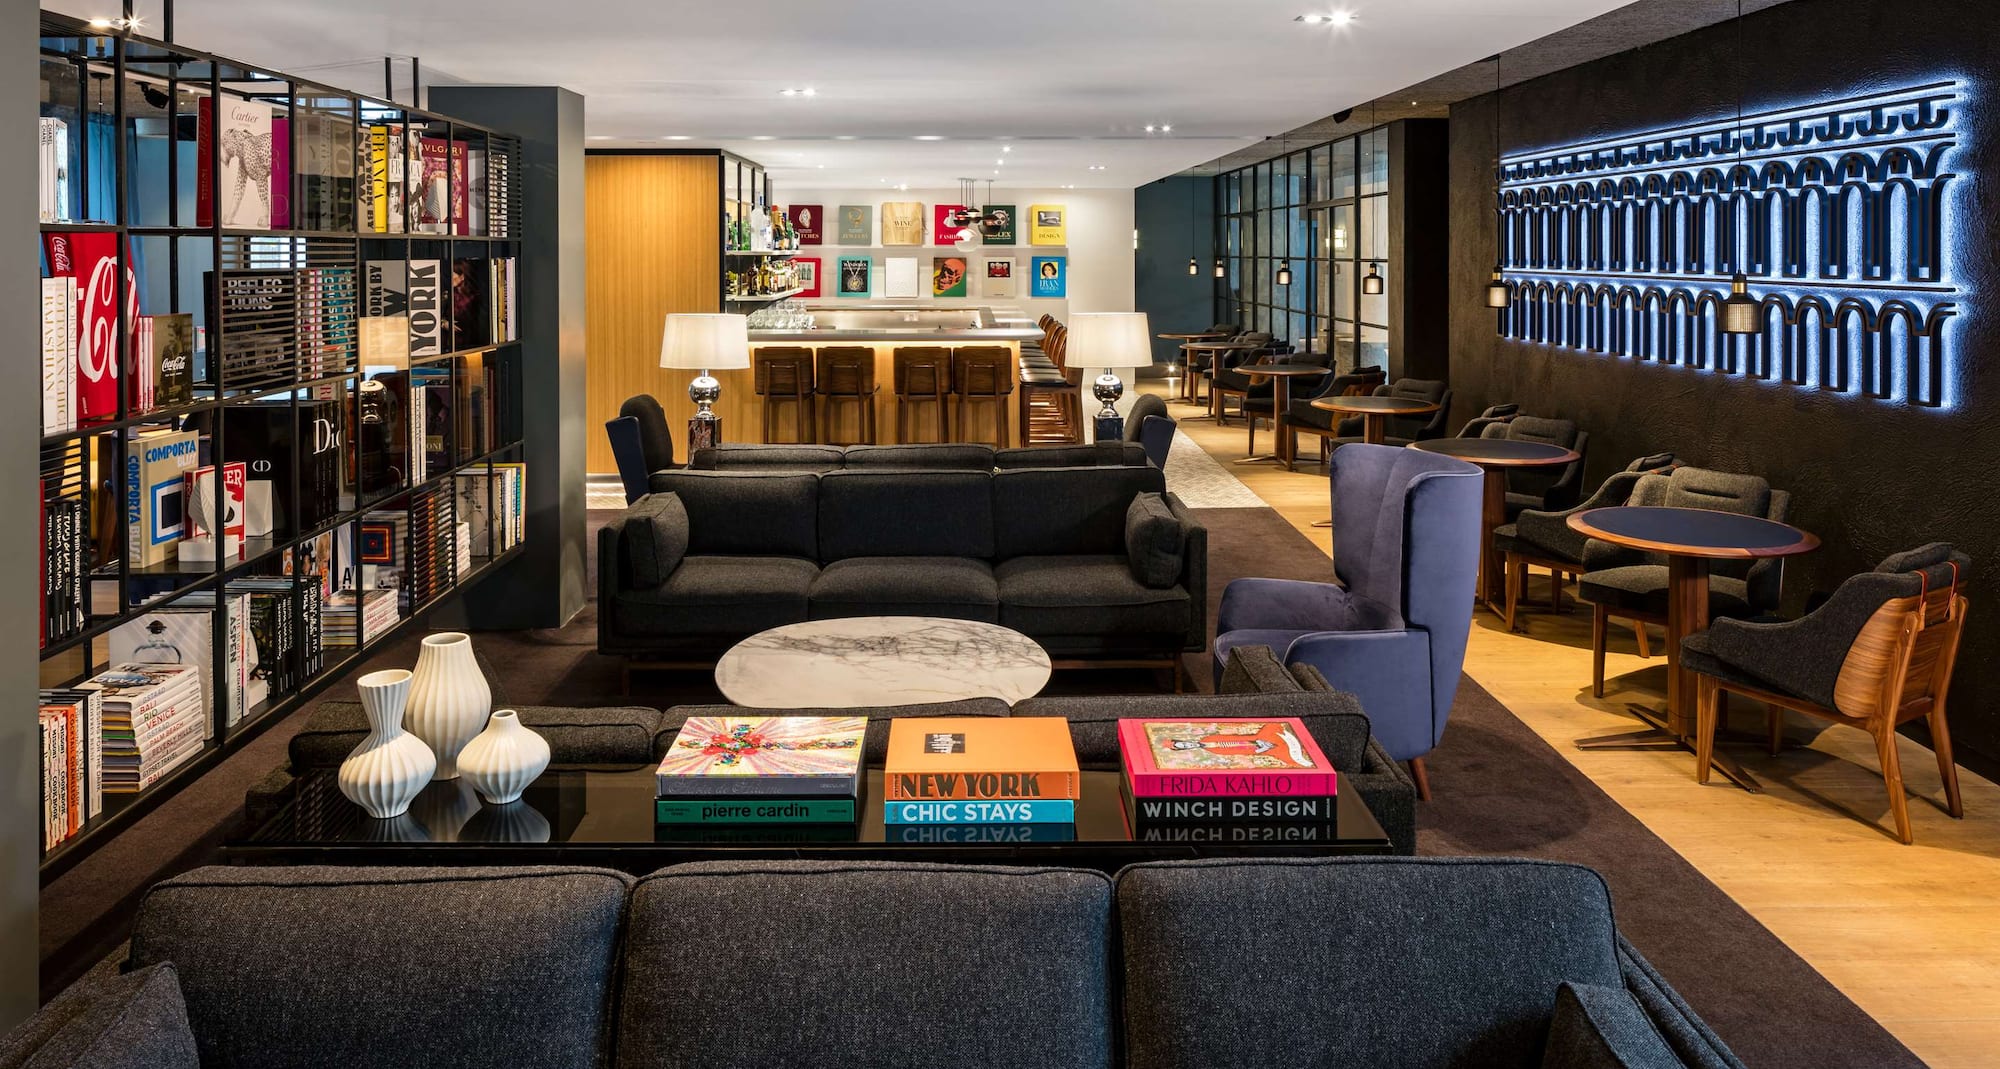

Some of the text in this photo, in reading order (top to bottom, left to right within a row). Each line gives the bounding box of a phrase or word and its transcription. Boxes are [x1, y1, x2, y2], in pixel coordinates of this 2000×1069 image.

[231, 106, 259, 123] Cartier
[422, 144, 462, 155] VLGRI
[372, 132, 386, 200] FRANCA
[366, 167, 374, 206] YORK
[367, 210, 374, 229] BY
[370, 266, 383, 317] ORK BY
[1040, 280, 1059, 288] IRAN
[410, 264, 436, 357] YORK
[44, 296, 56, 392] RAJASTHAN
[56, 293, 66, 376] OTTOMAN
[145, 440, 196, 463] COMPORTA
[128, 455, 140, 524] COMPORTA
[142, 686, 166, 704] GSTAAD
[140, 700, 157, 714] BALI
[144, 708, 158, 722] RIO
[146, 706, 176, 730] VENICE
[149, 721, 184, 746] PALM BEACH
[152, 736, 177, 758] BEVERLY
[177, 726, 193, 740] HILLS
[147, 770, 164, 784] BALI
[900, 773, 959, 798] NEW
[962, 772, 1041, 798] YORK
[1160, 775, 1292, 794] FRIDA KAHLO
[702, 803, 751, 820] pierre
[756, 803, 810, 817] cardin
[902, 803, 1032, 822] CHIC STAYS
[1143, 802, 1223, 818] WINCH
[1232, 800, 1316, 817] DESIGN
